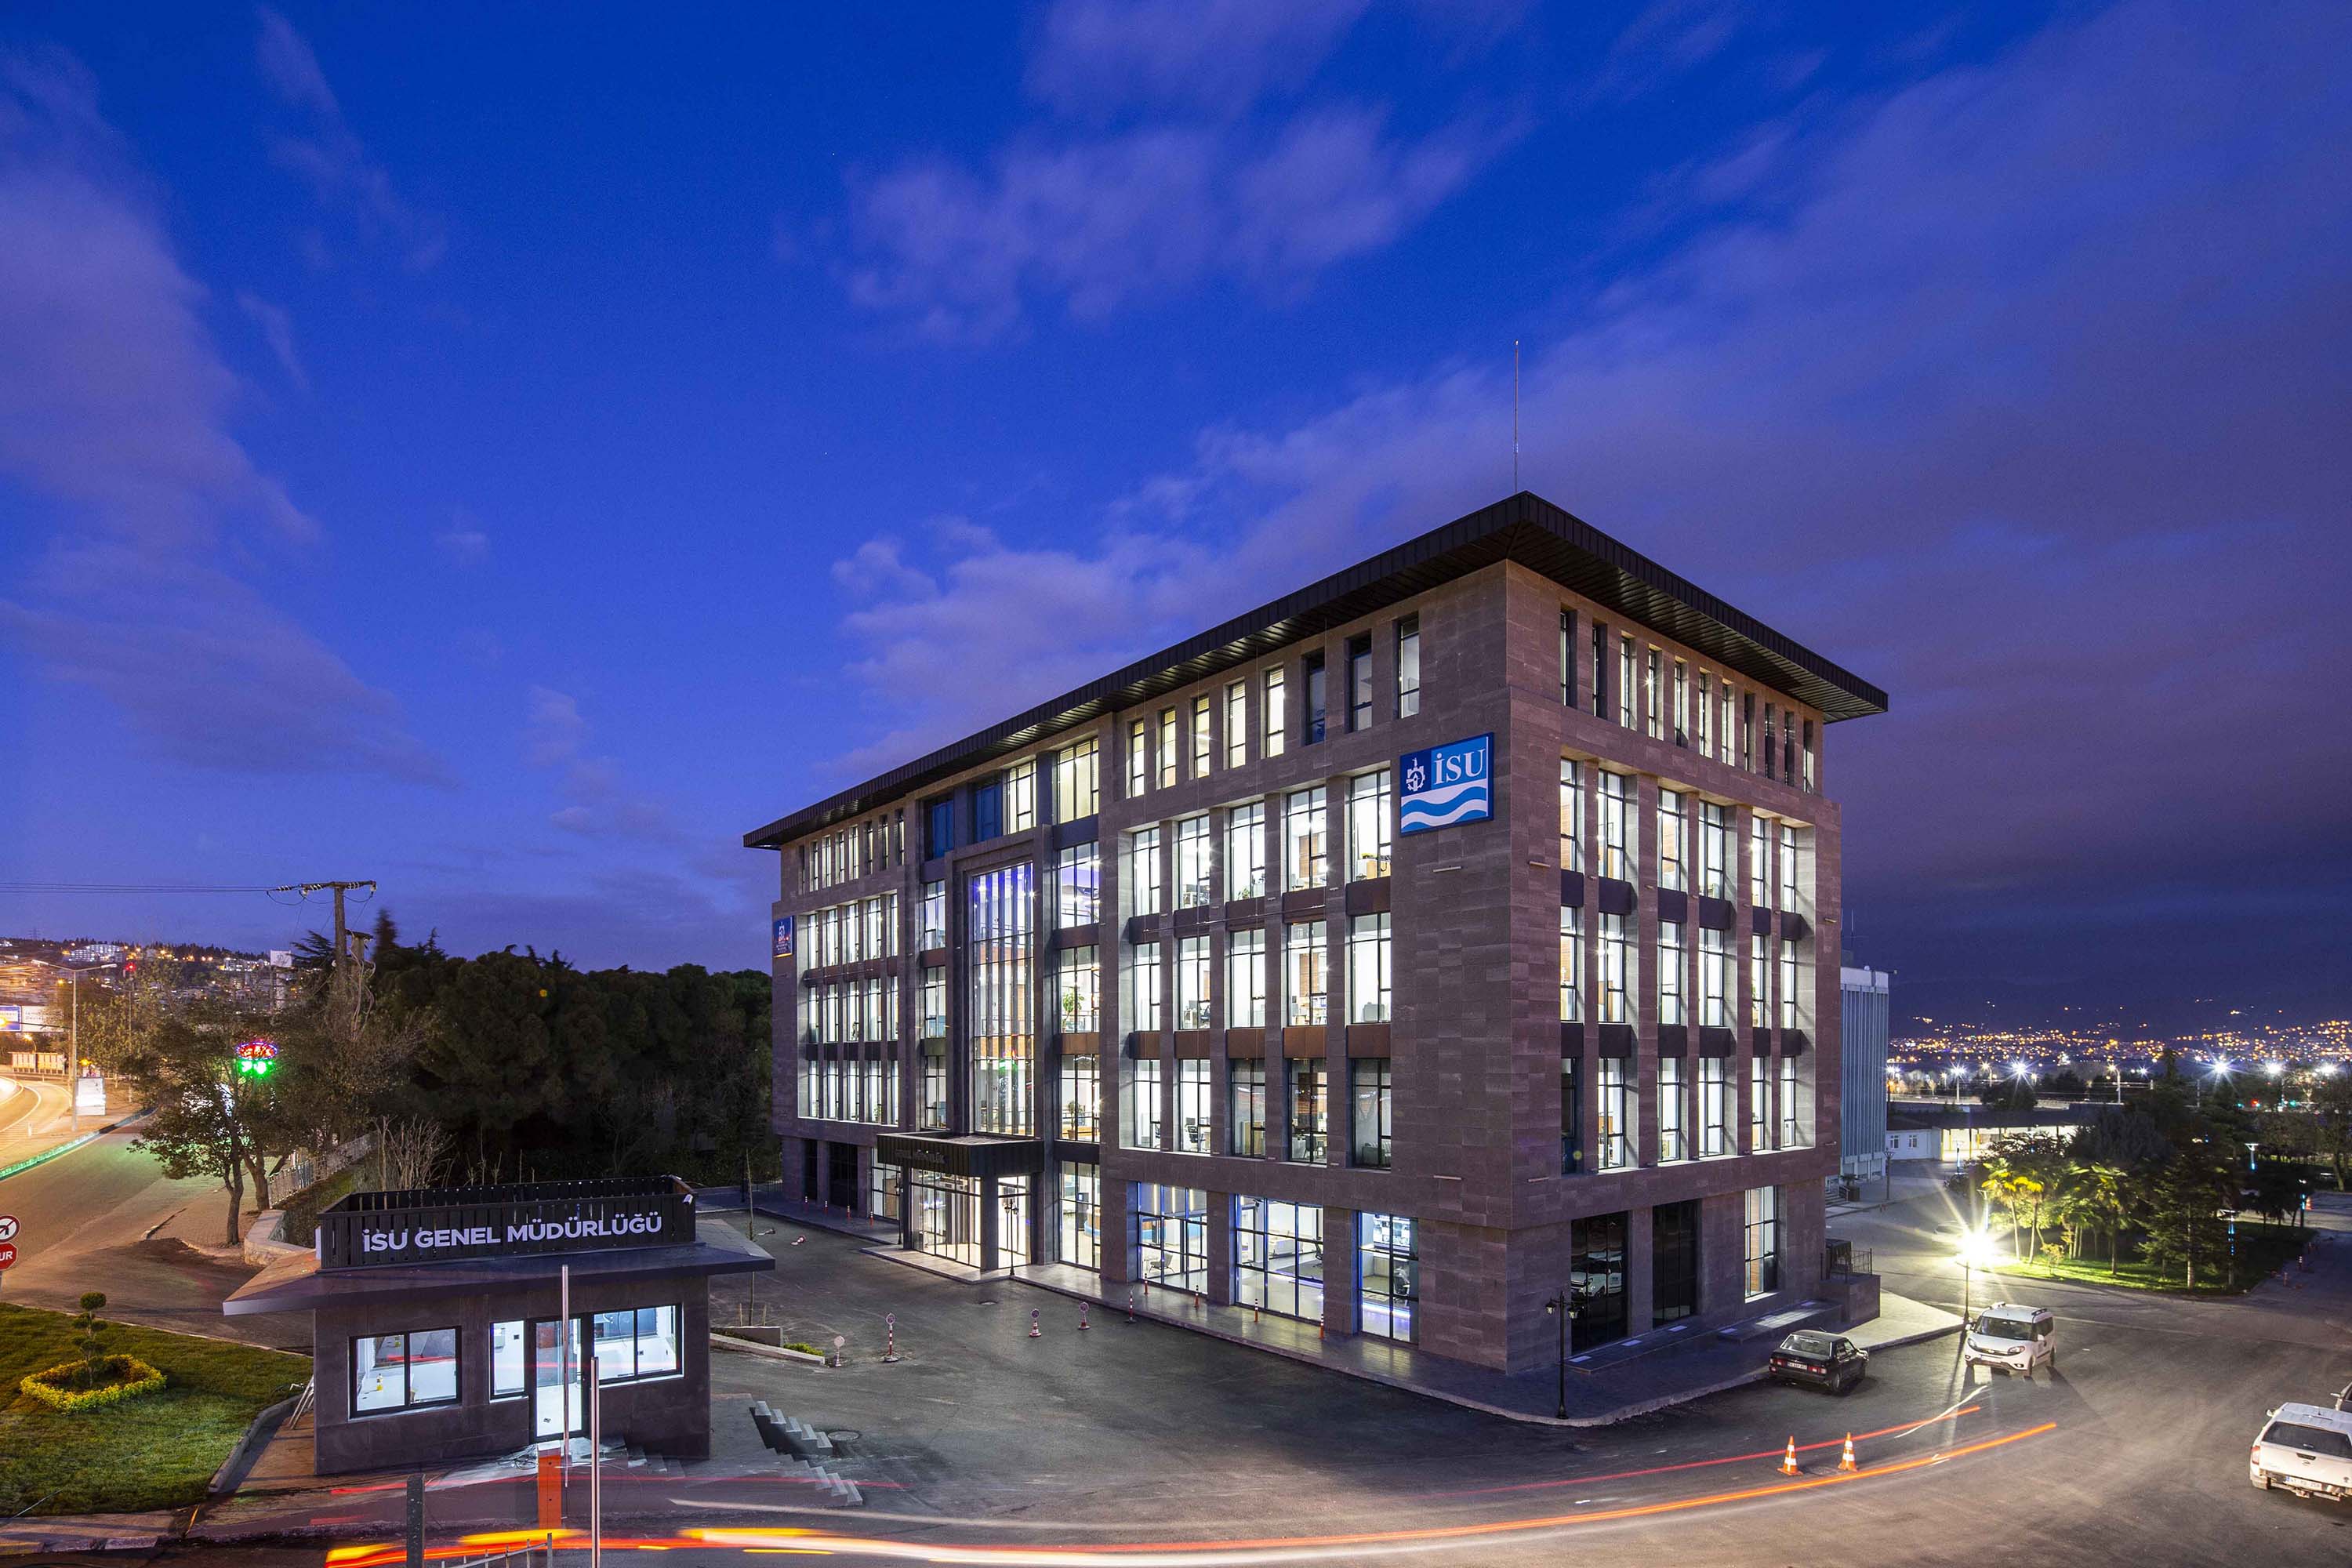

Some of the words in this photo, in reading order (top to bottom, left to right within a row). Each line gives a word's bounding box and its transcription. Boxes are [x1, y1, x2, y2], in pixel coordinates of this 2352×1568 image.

[414, 1226, 501, 1248] GENEL
[507, 1210, 662, 1243] MÜDÜRLÜĞÜ
[0, 1250, 13, 1261] UR
